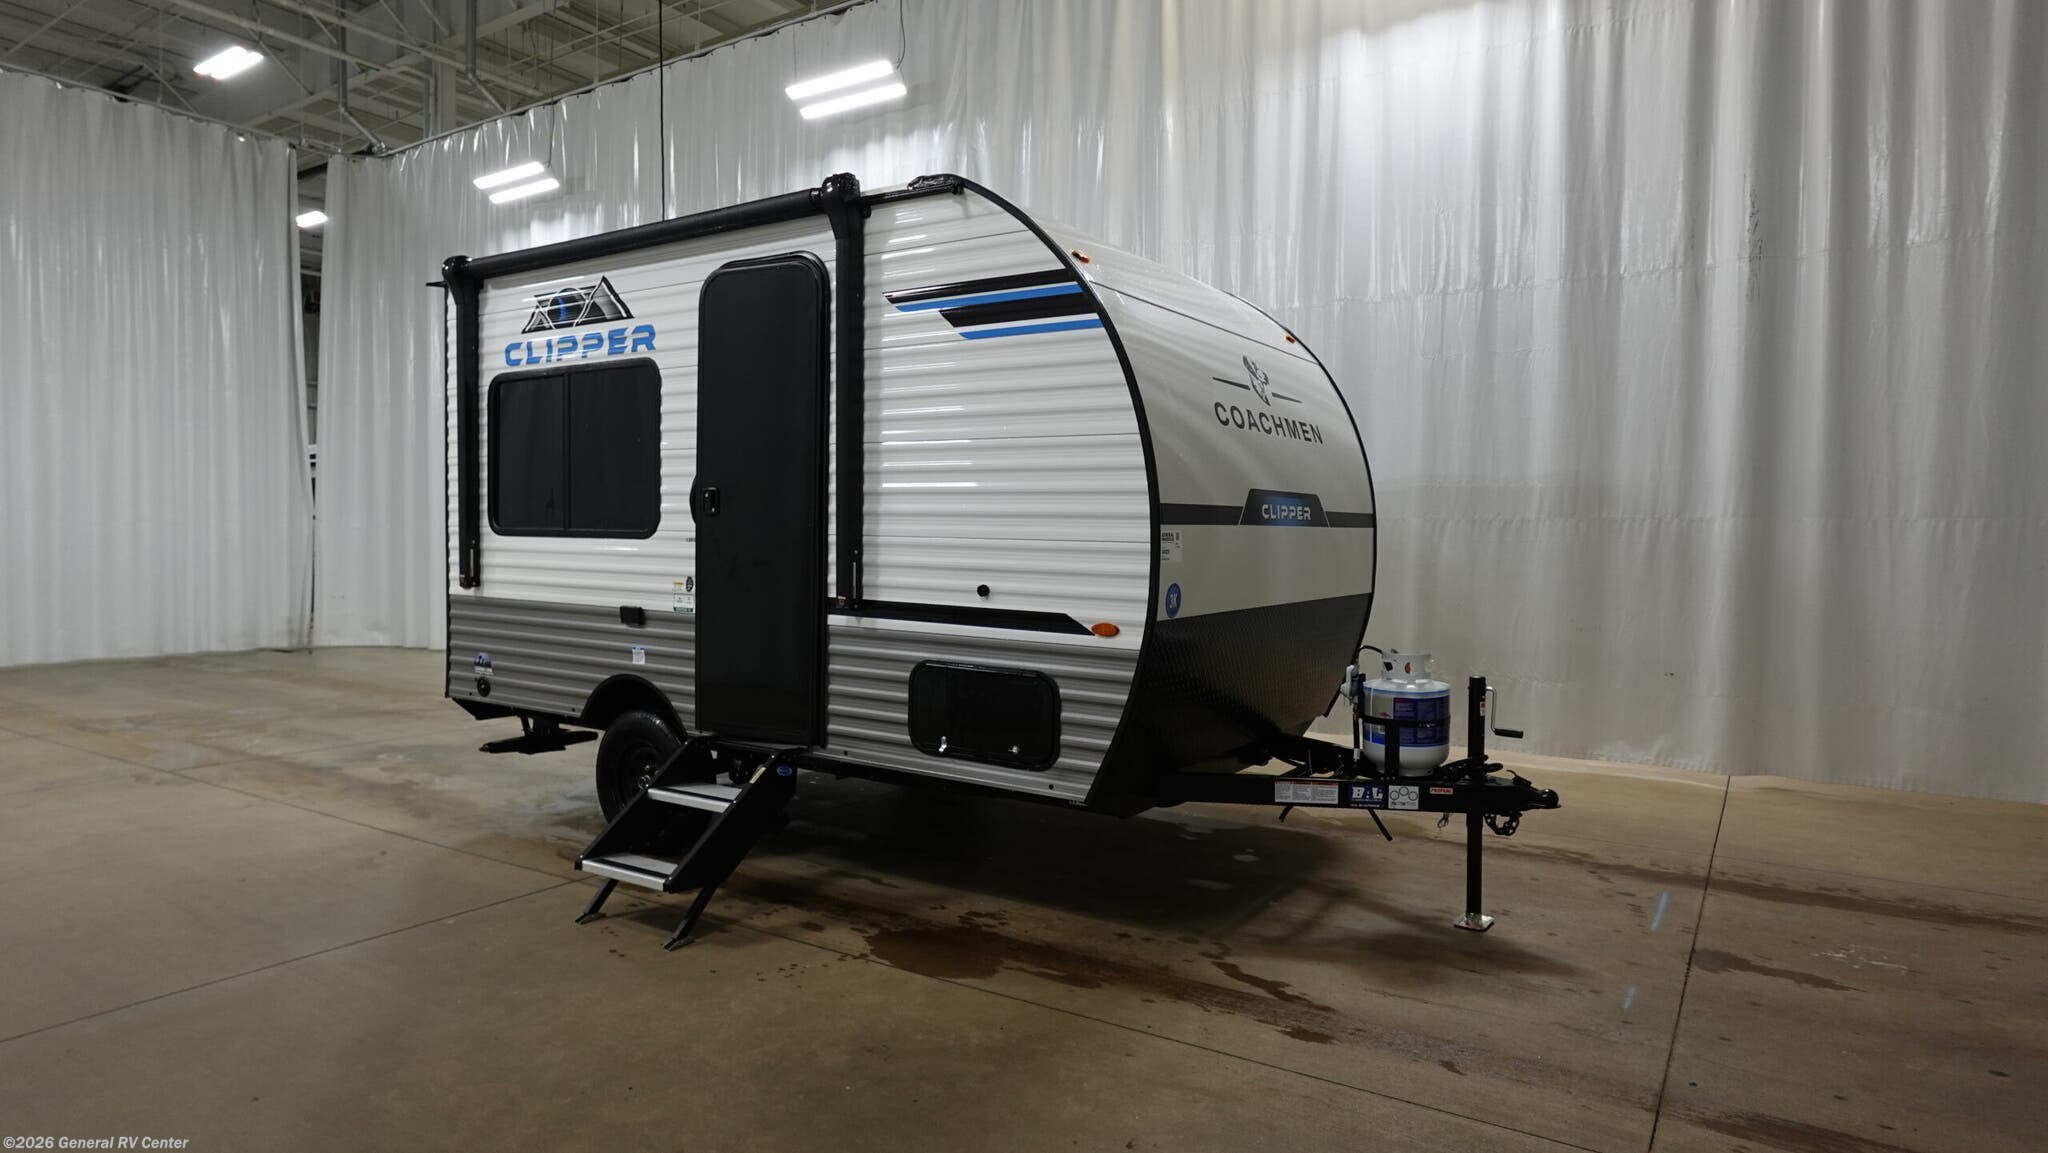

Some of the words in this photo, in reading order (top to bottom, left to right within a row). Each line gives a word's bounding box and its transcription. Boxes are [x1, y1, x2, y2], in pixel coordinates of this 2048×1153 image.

[504, 324, 656, 367] CLIPPER
[1214, 402, 1323, 444] COACHMEN
[1261, 504, 1312, 520] CLIPPER
